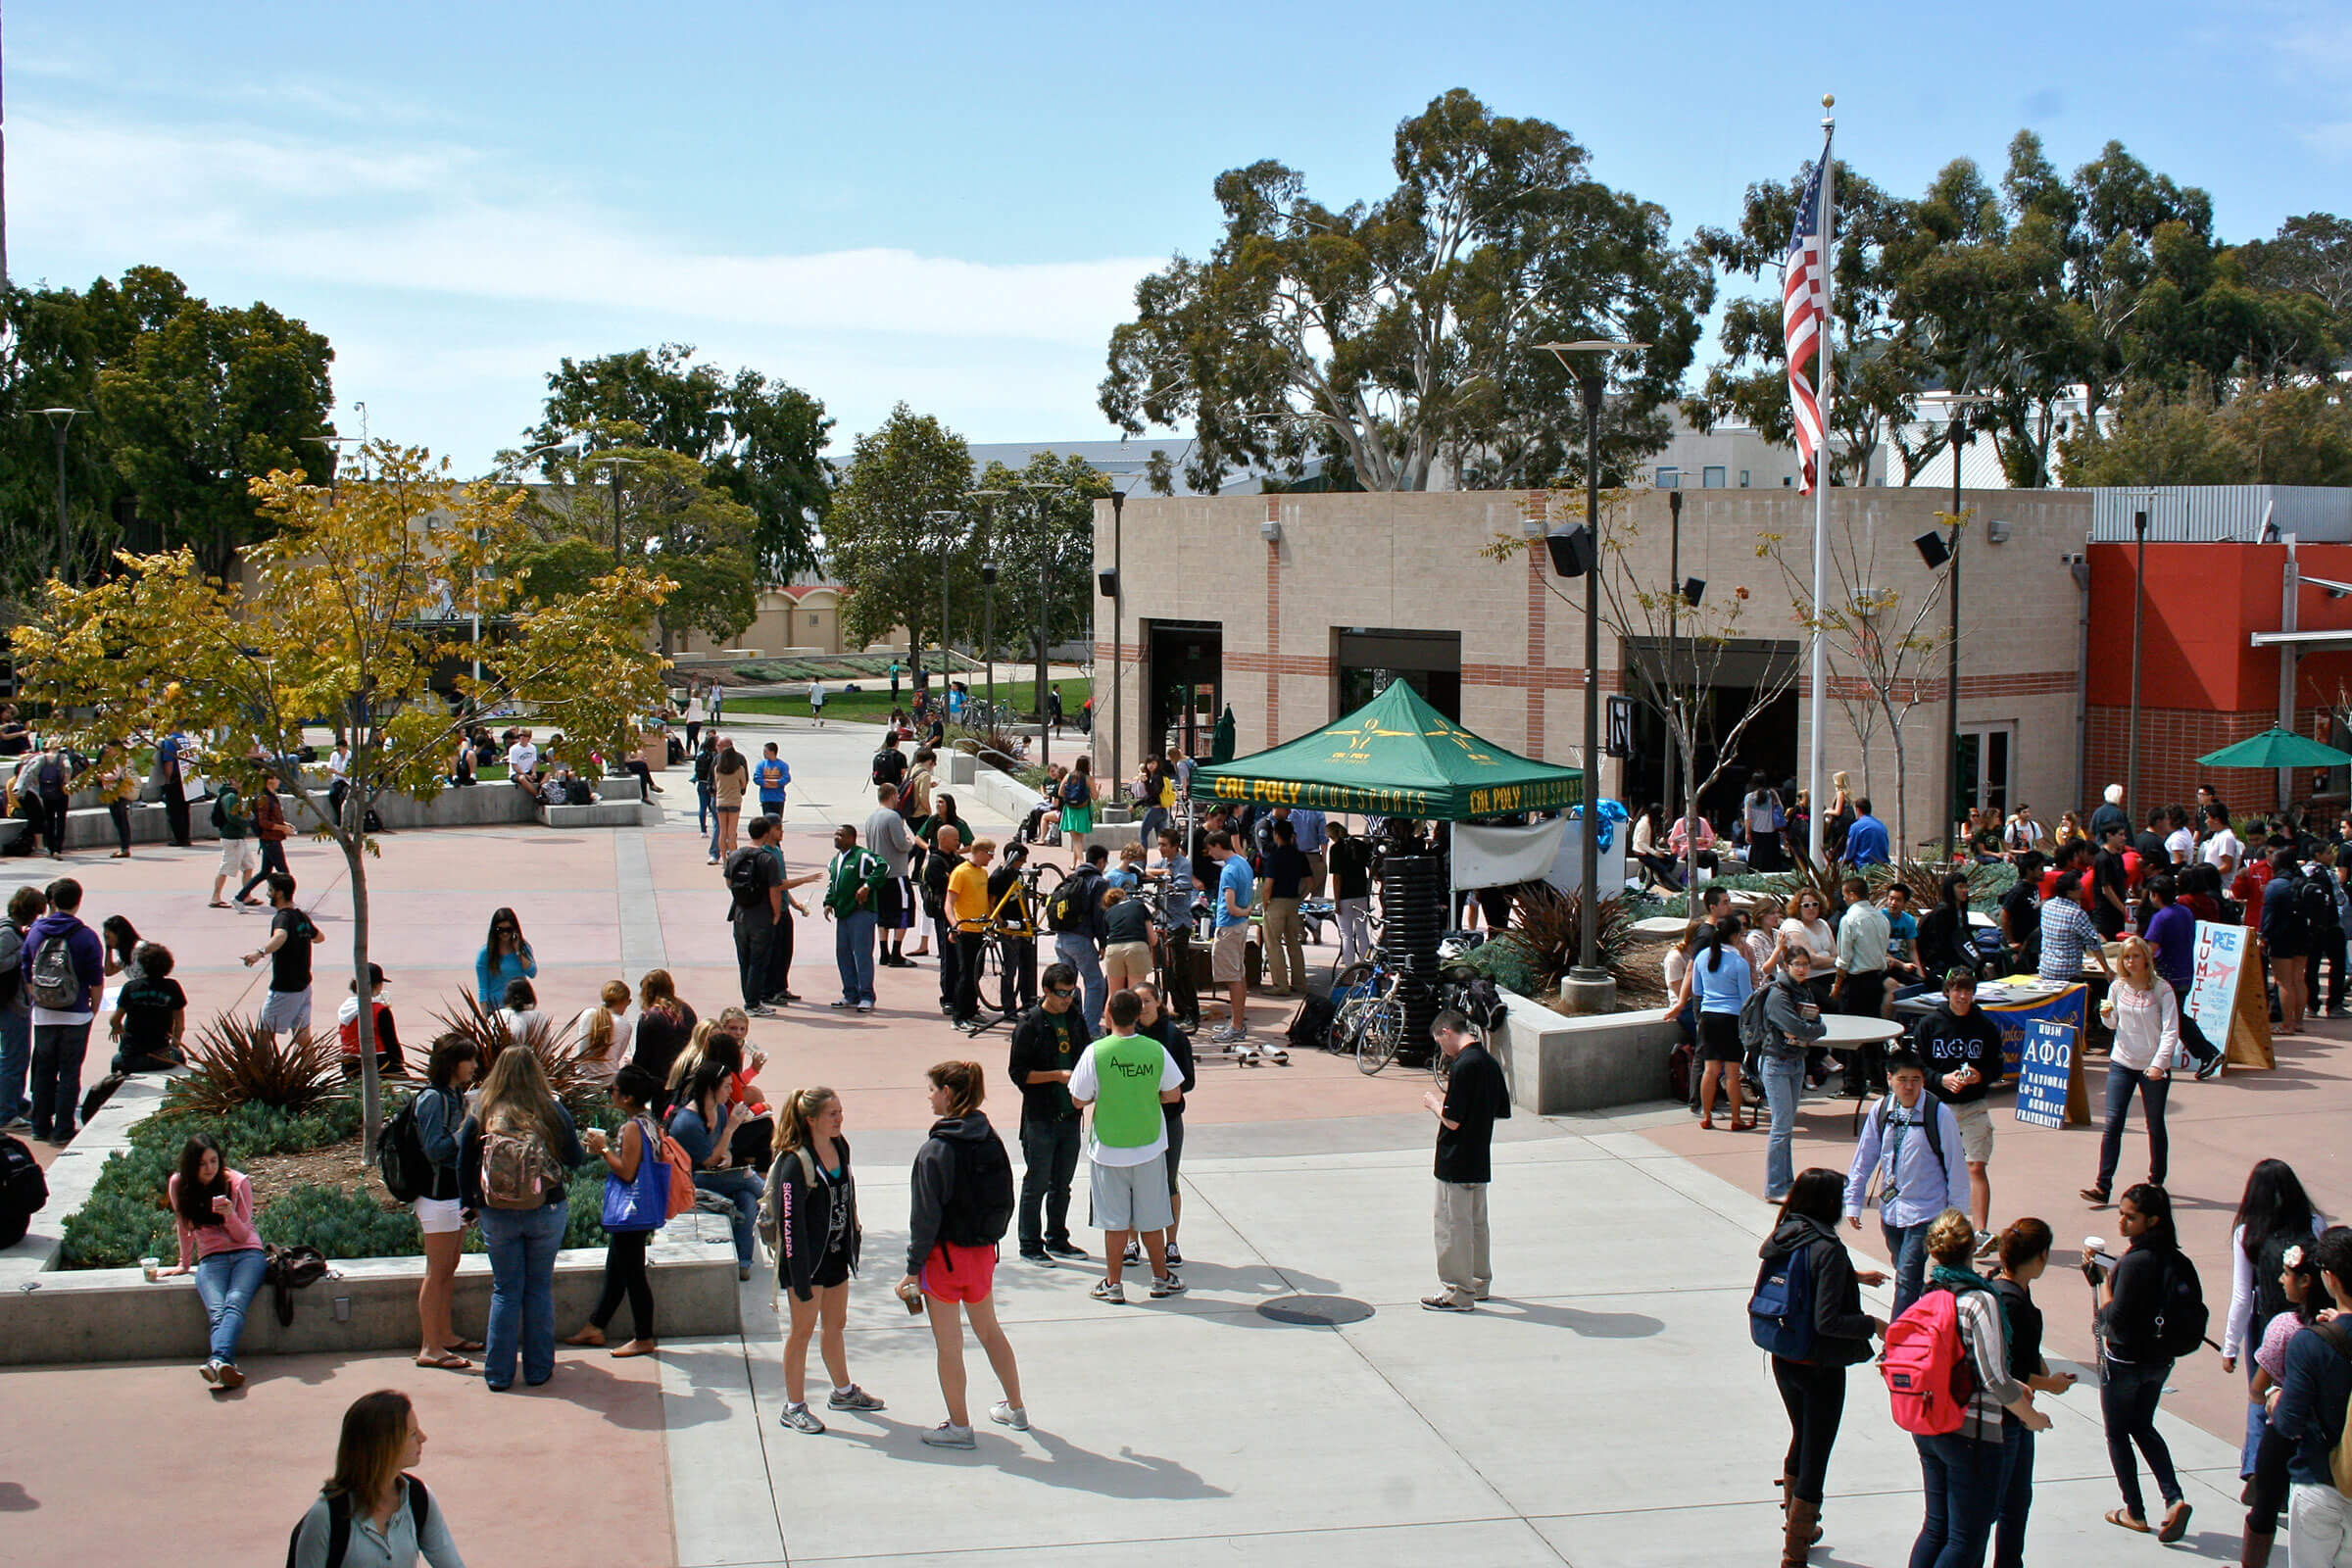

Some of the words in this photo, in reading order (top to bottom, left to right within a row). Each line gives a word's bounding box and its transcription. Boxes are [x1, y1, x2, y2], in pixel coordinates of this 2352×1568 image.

[1214, 776, 1250, 800] CAL
[1253, 779, 1301, 805] POLY
[1307, 783, 1350, 808] CLUB
[1357, 787, 1427, 814] SPORTS
[1470, 789, 1491, 814] CAL
[1493, 785, 1521, 811] POLY
[2038, 1023, 2062, 1037] RUSH
[1118, 1062, 1153, 1078] TEAM
[2019, 1081, 2044, 1099] CO-ED
[2028, 1071, 2069, 1091] NATIONAL
[2028, 1098, 2065, 1116] SERVICE
[2016, 1108, 2062, 1130] FRATERNITY
[782, 1182, 793, 1218] SIGMA
[784, 1219, 793, 1258] KAPPA
